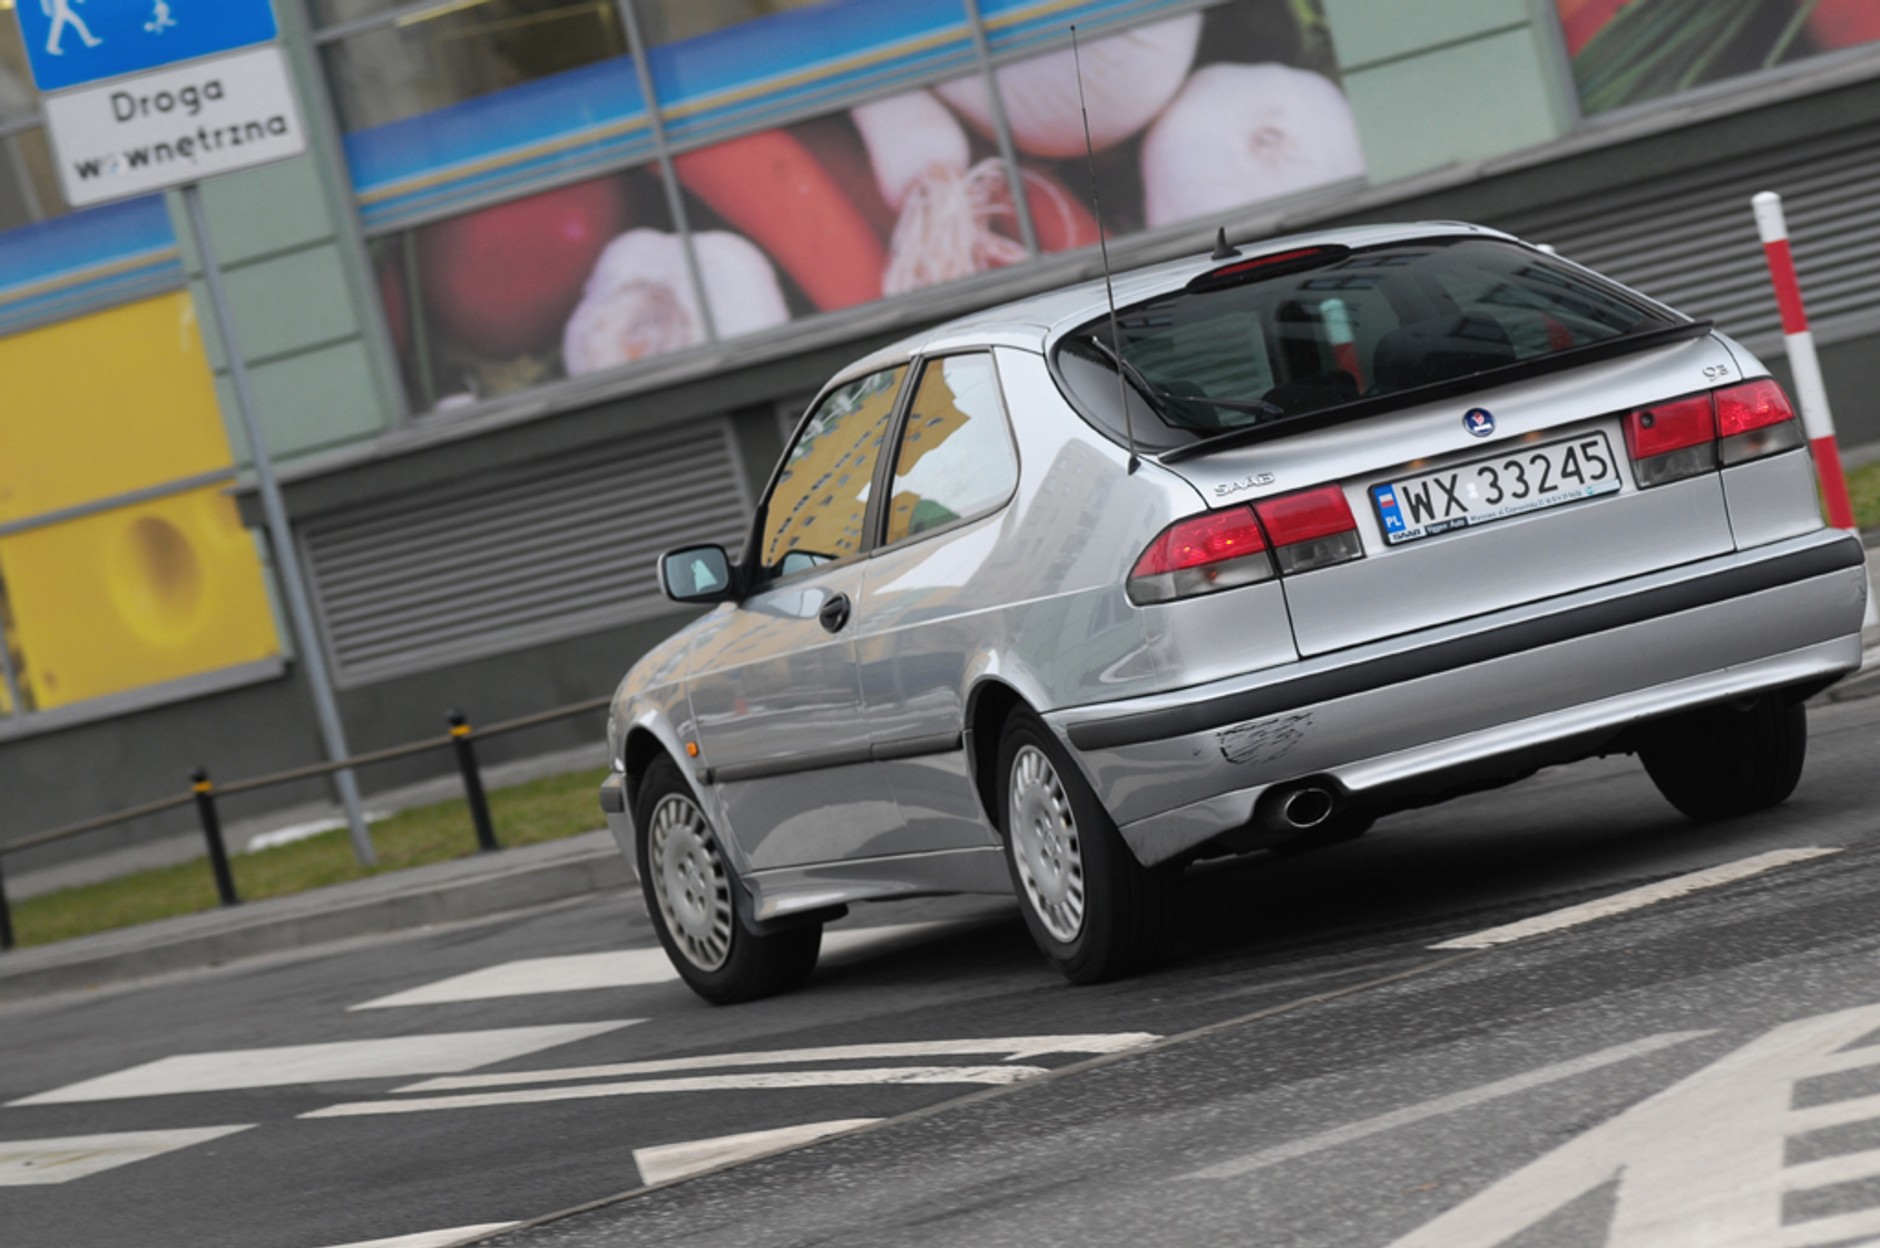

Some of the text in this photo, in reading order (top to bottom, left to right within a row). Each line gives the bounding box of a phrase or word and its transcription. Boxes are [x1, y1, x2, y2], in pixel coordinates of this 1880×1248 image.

[111, 80, 223, 123] Droga
[75, 115, 287, 180] wwnętrzna
[1214, 472, 1275, 497] SAAB
[1402, 473, 1468, 524] WX
[1477, 440, 1608, 505] 33245
[1385, 515, 1402, 528] PL
